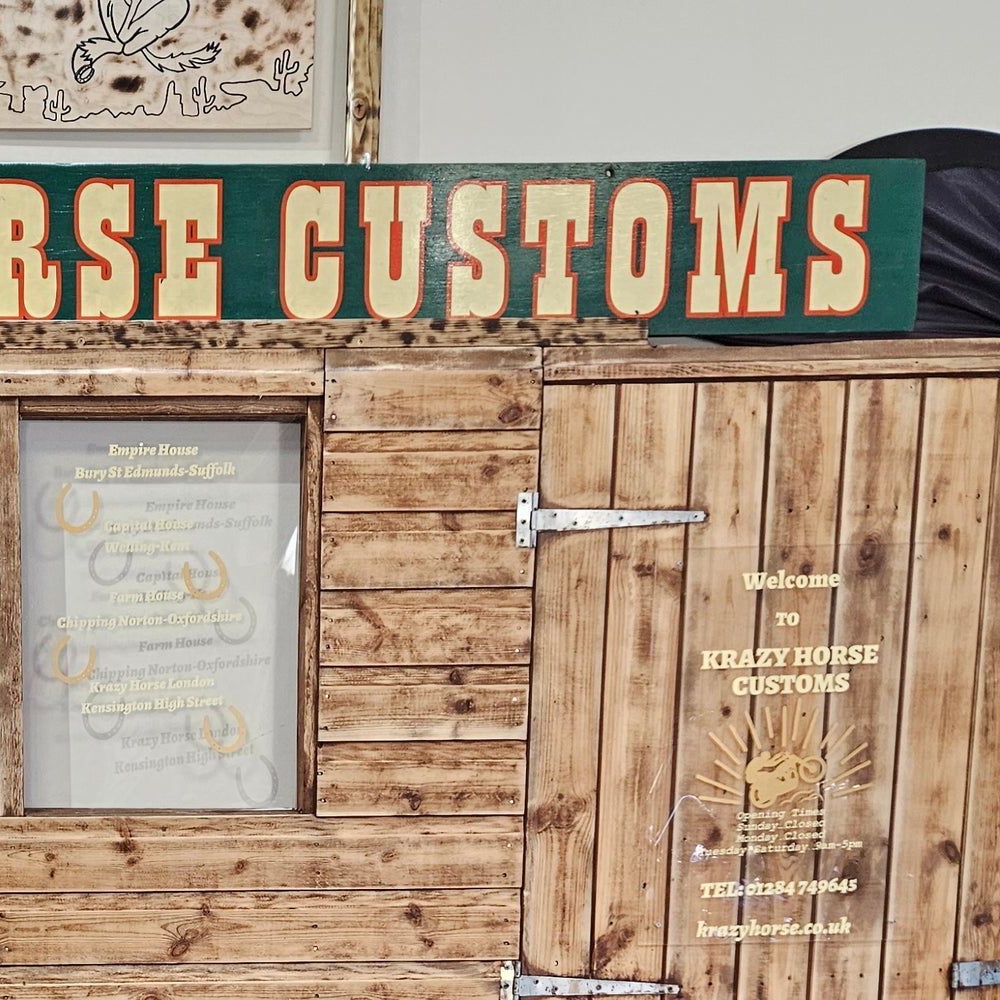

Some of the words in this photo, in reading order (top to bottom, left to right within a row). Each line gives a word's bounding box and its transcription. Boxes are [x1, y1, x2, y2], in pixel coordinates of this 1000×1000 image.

[280, 174, 871, 320] CUSTOMS
[108, 442, 157, 459] Empire
[157, 443, 199, 456] House
[74, 466, 107, 481] Bury
[108, 466, 123, 479] St
[123, 464, 236, 480] Edmunds-Suffolk
[742, 570, 840, 591] Welcome
[57, 616, 117, 631] Chipping
[775, 611, 800, 626] TO
[700, 646, 791, 670] KRAZY
[792, 644, 880, 667] HORSE
[89, 679, 128, 695] Krazy
[130, 679, 166, 692] Horse
[168, 676, 215, 689] London
[732, 672, 850, 696] CUSTOMS
[81, 701, 152, 717] Kensington
[154, 698, 185, 712] High
[186, 695, 224, 708] Street
[736, 811, 786, 821] Opening
[791, 808, 826, 817] Times
[700, 882, 744, 898] TEL:
[747, 880, 795, 897] 01284
[798, 877, 858, 895] 749645
[696, 917, 851, 942] krazyhorse.co.uk
